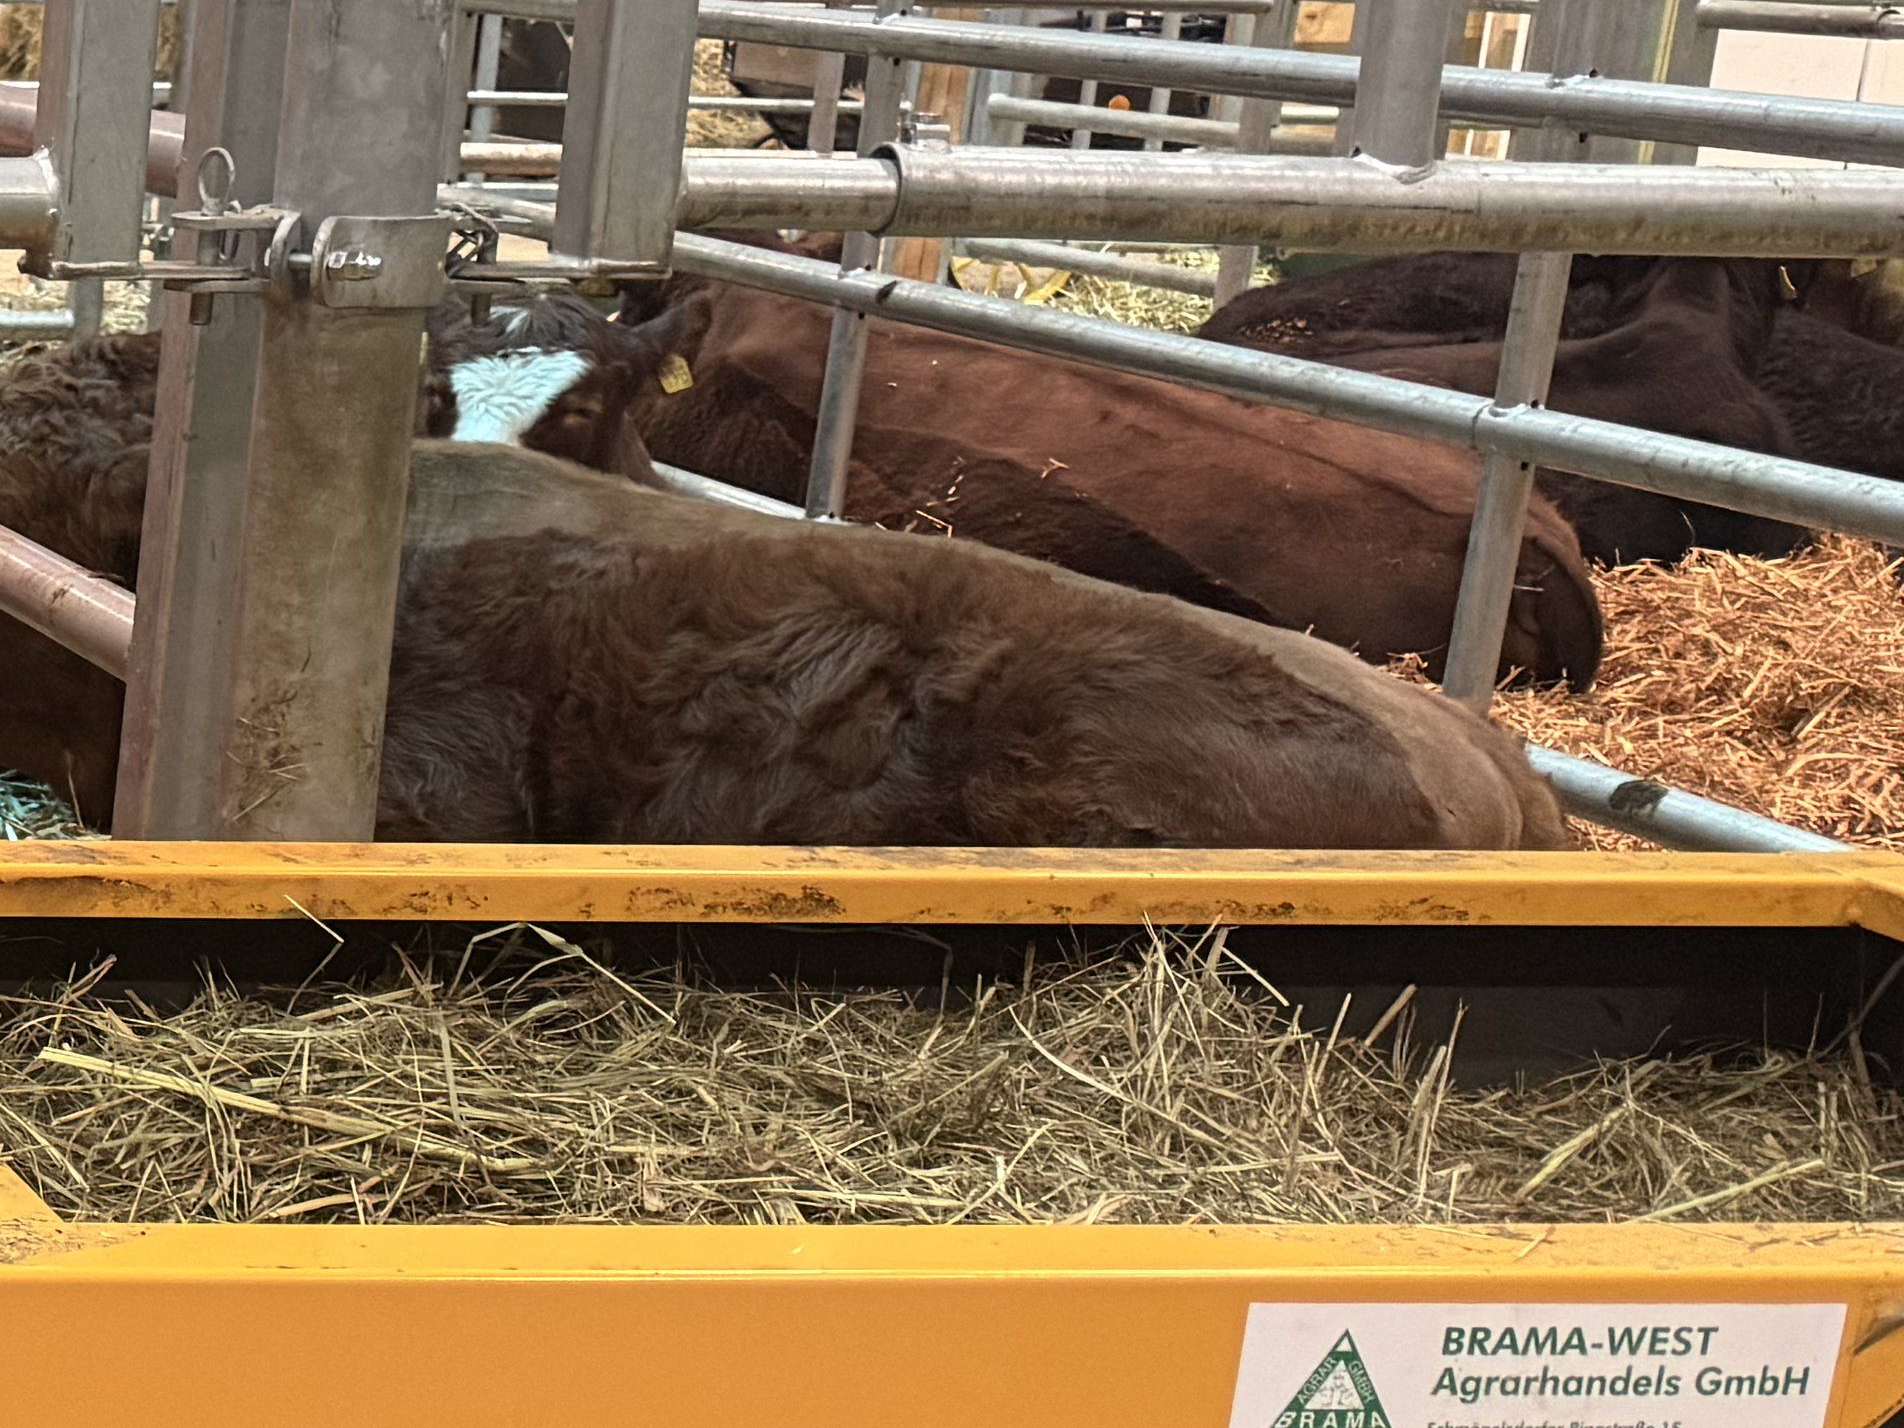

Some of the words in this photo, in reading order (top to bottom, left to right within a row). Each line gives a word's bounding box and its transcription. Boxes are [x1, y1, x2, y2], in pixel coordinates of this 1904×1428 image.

[1441, 1325, 1720, 1357] BRAMA-WEST
[1297, 1357, 1337, 1404] AGRAR
[1430, 1364, 1682, 1404] Agrarhandels
[1694, 1364, 1811, 1397] GmbH
